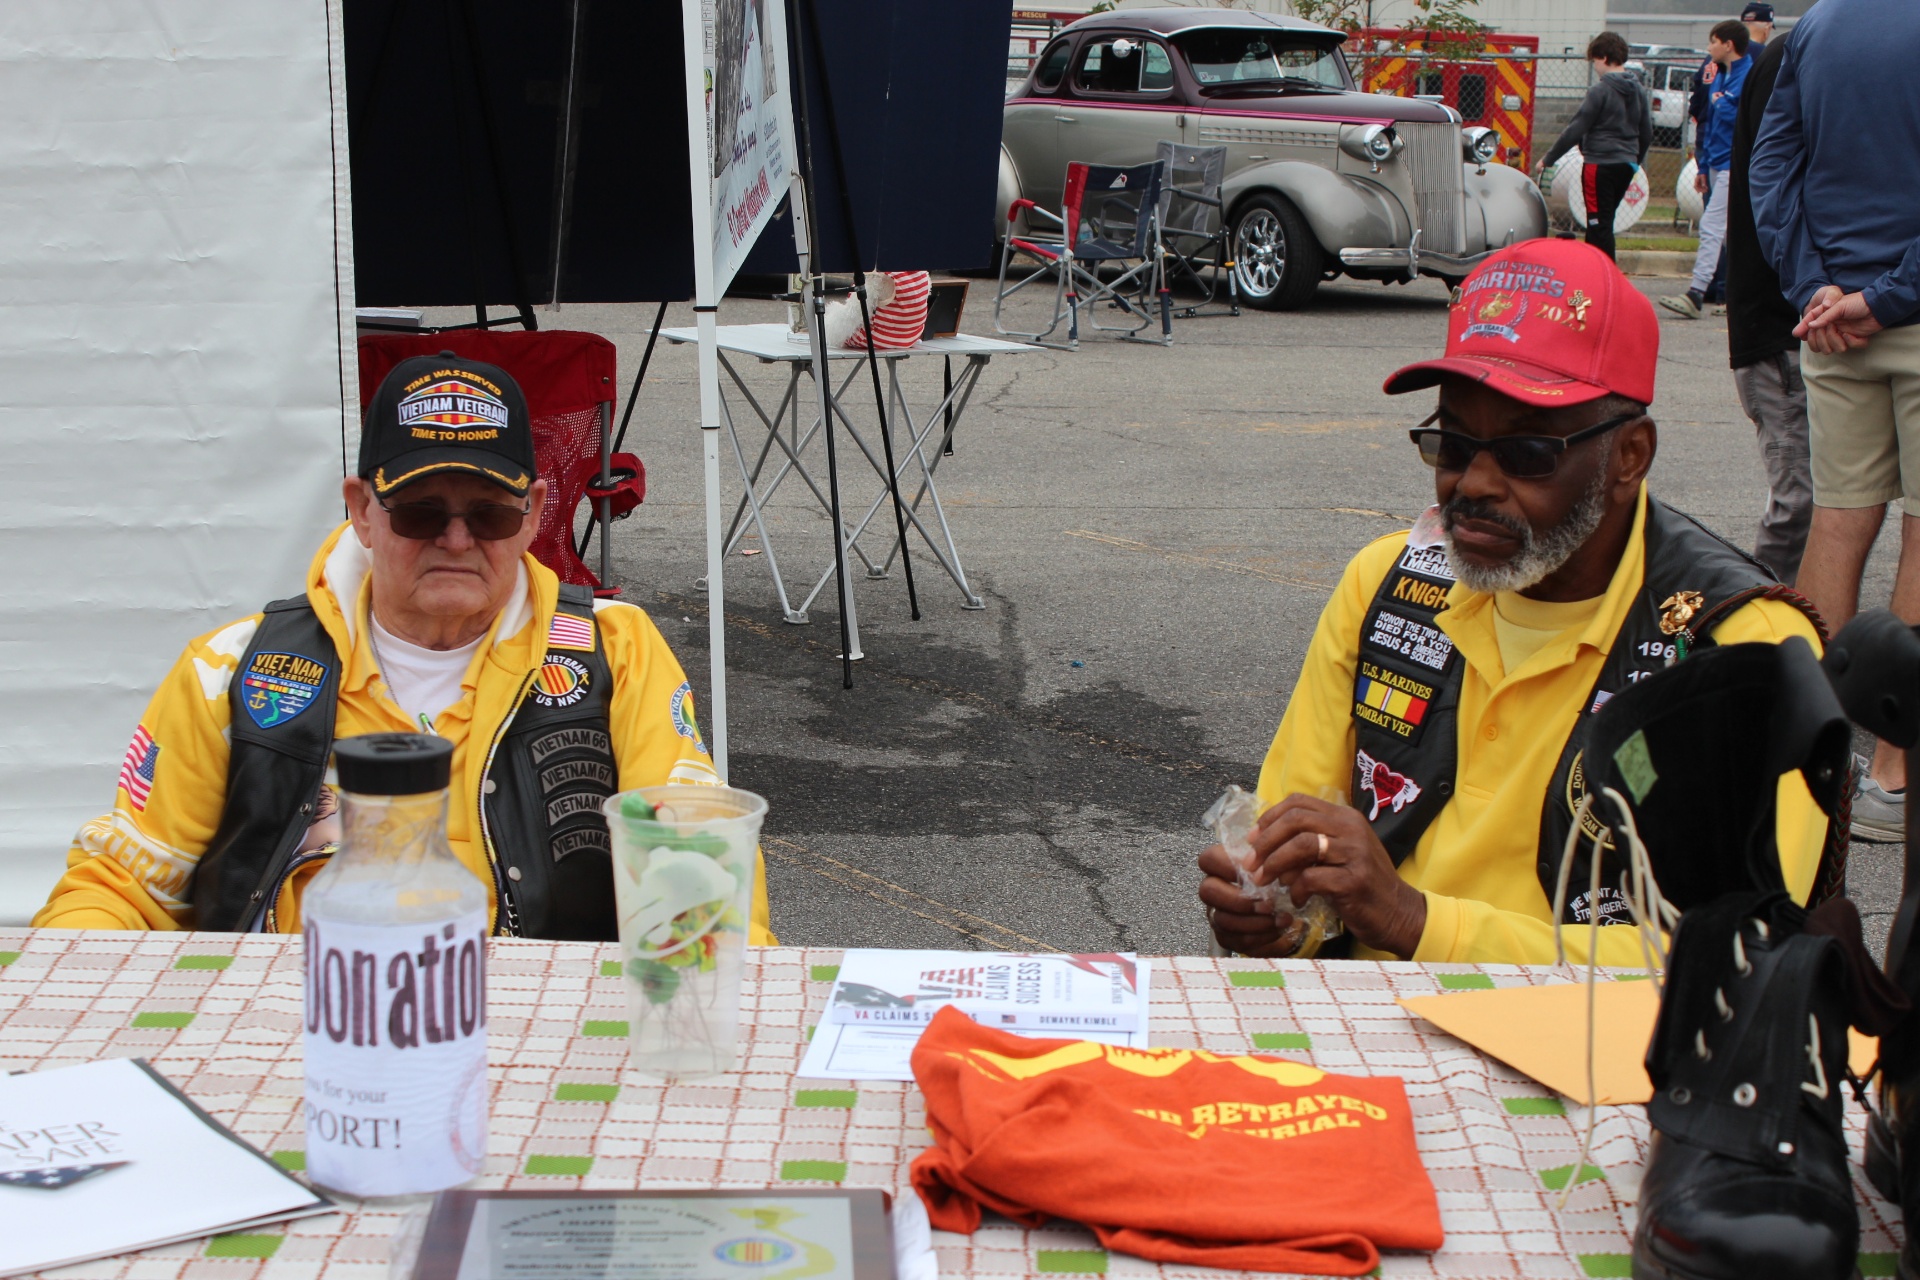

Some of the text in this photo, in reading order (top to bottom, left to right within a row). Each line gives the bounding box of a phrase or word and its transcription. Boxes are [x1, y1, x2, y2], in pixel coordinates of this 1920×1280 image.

[1511, 262, 1555, 277] STATES
[1464, 271, 1566, 298] MARINES
[404, 375, 431, 392] TIME
[401, 397, 506, 424] VIETNAM VETERAN
[411, 427, 498, 441] TIME TO HONOR
[1407, 558, 1456, 577] MEMB
[1374, 619, 1452, 654] DIED FOR YOU
[1378, 611, 1404, 628] HONOR
[1406, 620, 1420, 633] THE
[1422, 626, 1438, 640] TWO
[1369, 631, 1448, 661] JESUS & AMERICAN
[255, 654, 324, 680] VIET-NAM
[545, 655, 588, 675] VETERAN
[1410, 651, 1445, 671] SOLDIER
[250, 665, 278, 677] NAVY
[279, 672, 321, 686] SERVICE
[1362, 661, 1433, 699] U.S. MARINES
[536, 686, 587, 707] US NAVY
[672, 688, 686, 730] VIETNAM
[1355, 703, 1413, 738] COMBAT VET
[533, 731, 606, 756] VIETNAM 66
[542, 763, 612, 786] VIETNAM 67
[550, 796, 599, 818] VIETNAM
[553, 832, 601, 855] VIETNAM
[1570, 896, 1585, 912] WE
[1583, 887, 1611, 903] WNT
[1575, 900, 1629, 922] STRNGERS
[985, 965, 1011, 1001] CLAIMS
[1016, 962, 1041, 1005] SUCCESS
[854, 1010, 869, 1020] VA
[874, 1011, 919, 1021] CLAIMS
[1084, 1017, 1117, 1026] KIMBLE
[347, 1088, 388, 1105] your
[1191, 1095, 1388, 1126] BETRAYED
[16, 1138, 124, 1166] SAFE
